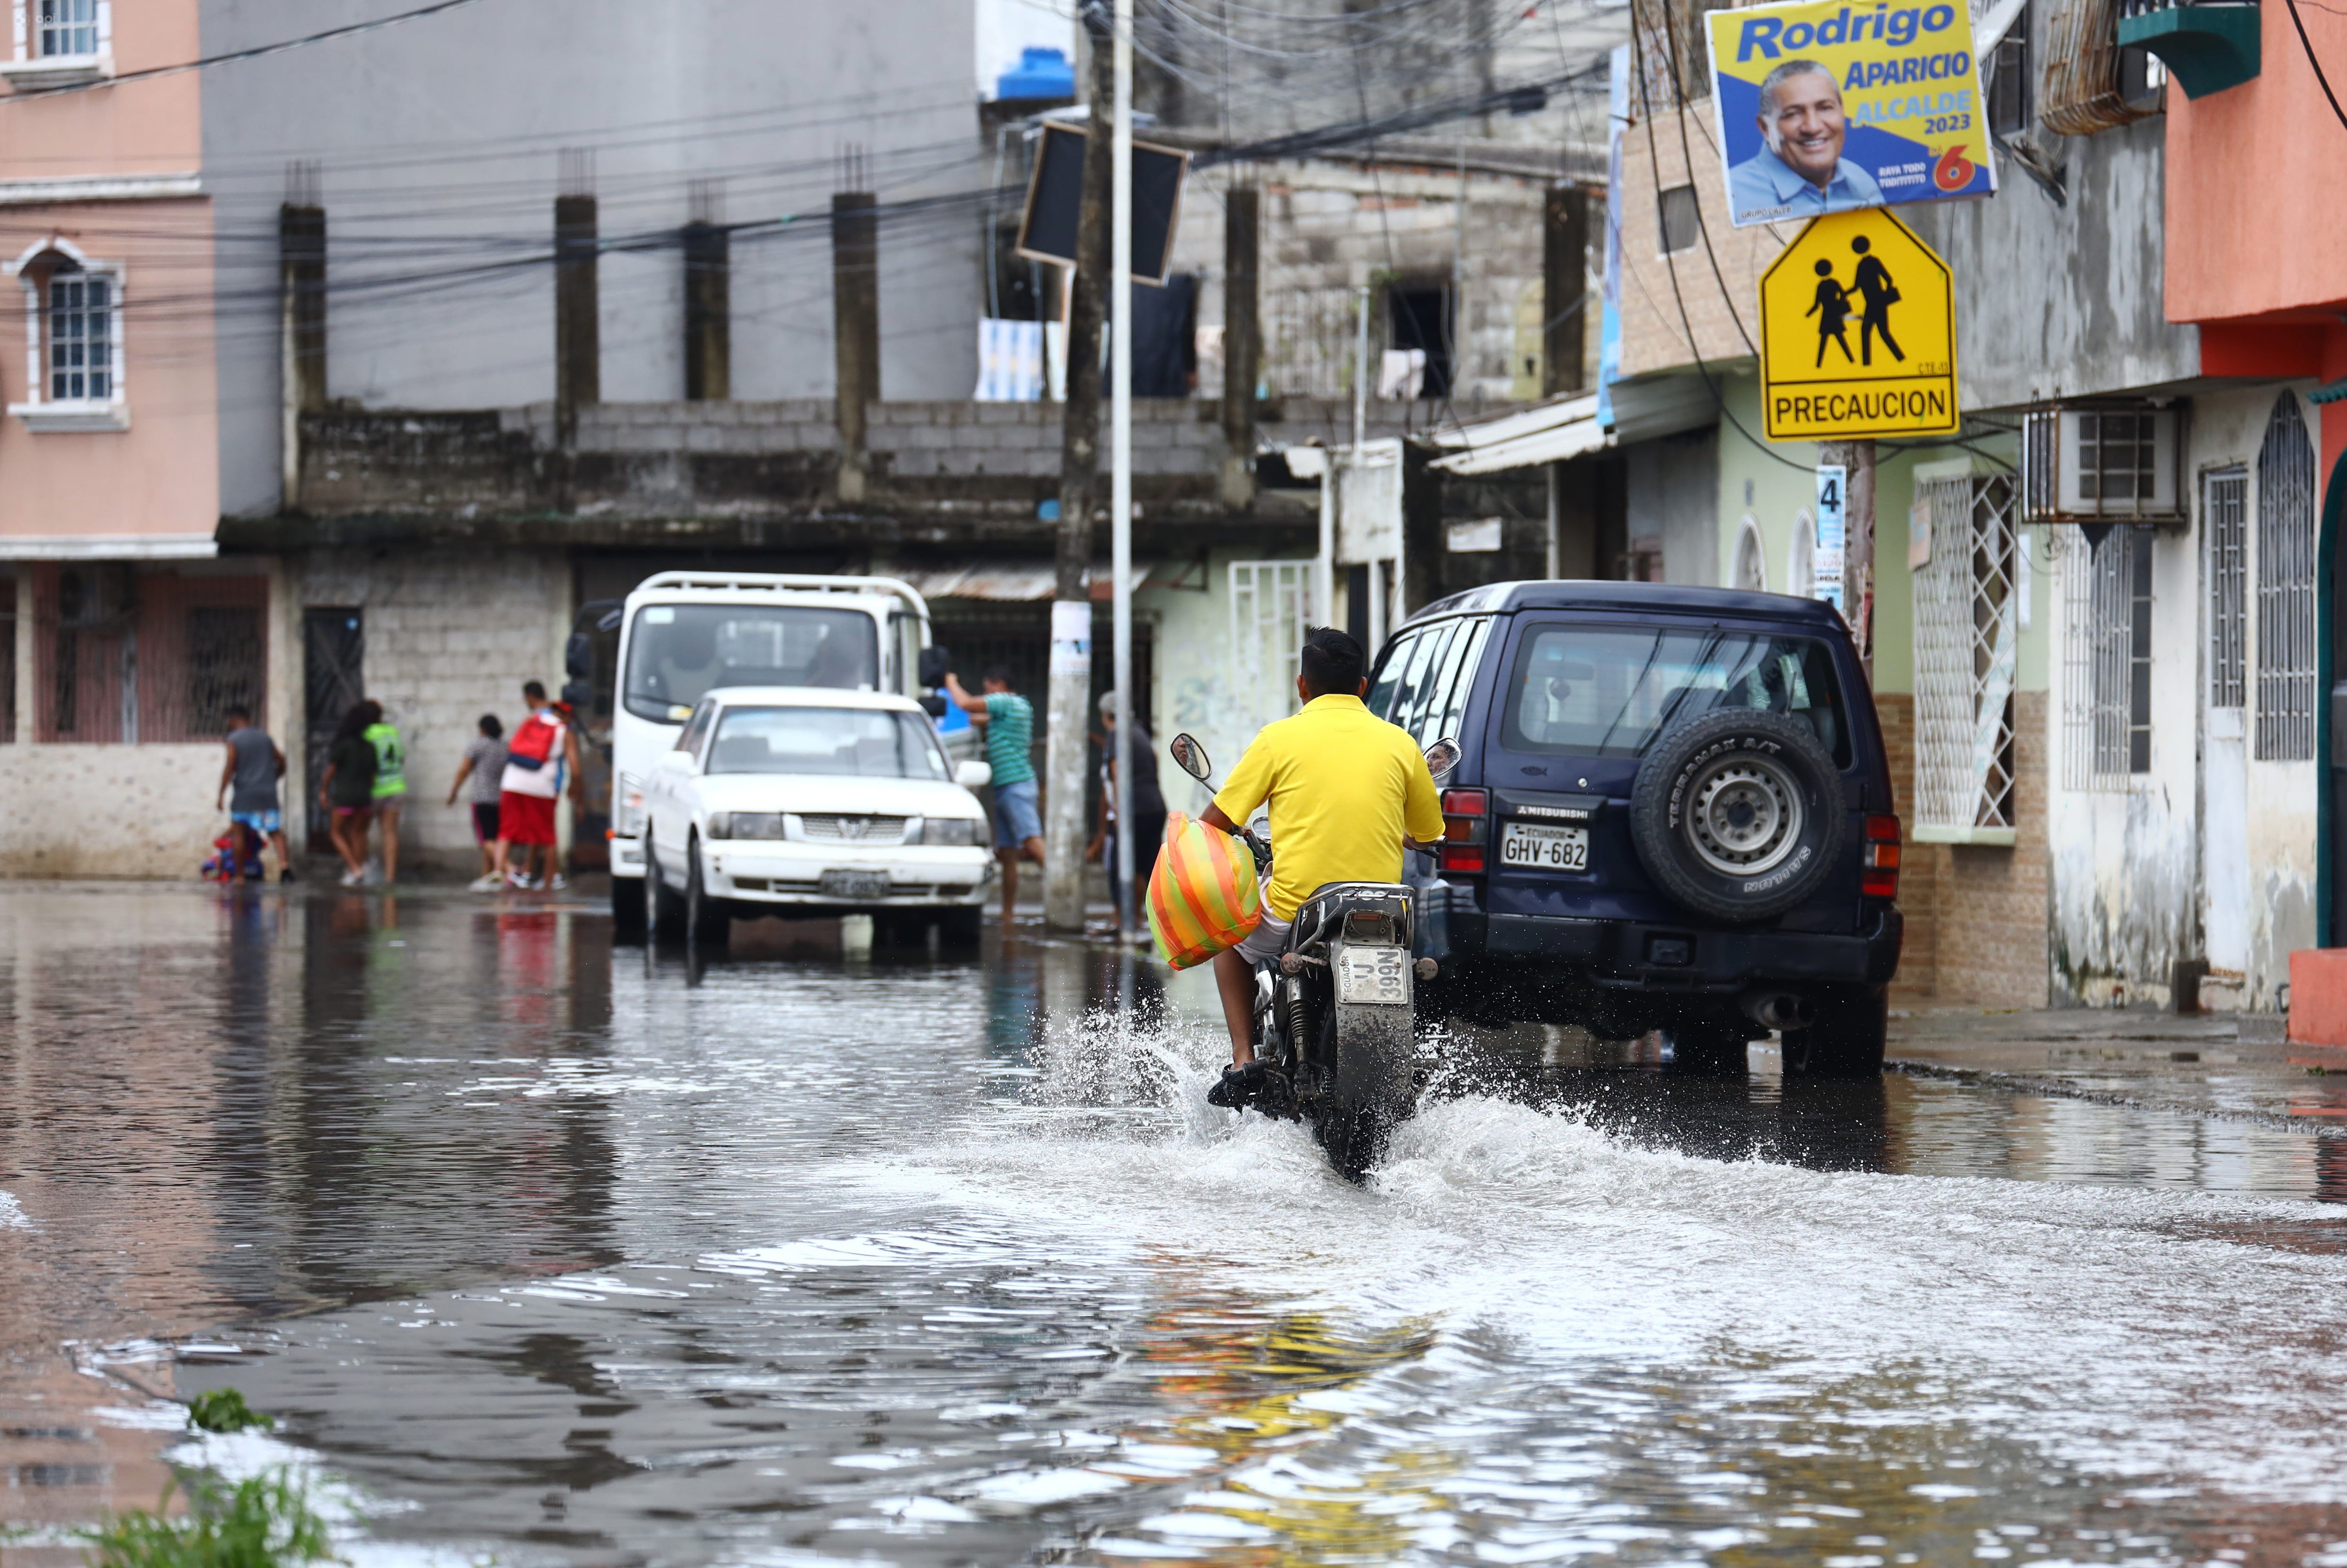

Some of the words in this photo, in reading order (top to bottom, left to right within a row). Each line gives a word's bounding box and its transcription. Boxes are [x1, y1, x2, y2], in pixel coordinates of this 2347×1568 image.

[1737, 4, 1954, 62] Rodrigo
[1843, 51, 1971, 91] APARICIO
[1854, 89, 1972, 126] ALCALDE
[1925, 114, 1971, 135] 2023
[1879, 165, 1901, 177] RAYA
[1902, 161, 1926, 173] TODO
[1933, 144, 1975, 192] 6
[1741, 208, 1767, 219] GRUPO
[1776, 390, 1945, 424] PRECAUCION
[1821, 479, 1841, 512] 4
[1670, 738, 1735, 829] TERRAMAX
[1743, 737, 1781, 754] A/T
[1528, 806, 1588, 819] MITSUBISHI
[1527, 828, 1566, 840] ECUADOR
[1506, 838, 1585, 866] GHV-682
[1744, 846, 1811, 892] SAILUN
[1377, 952, 1402, 998] 399N
